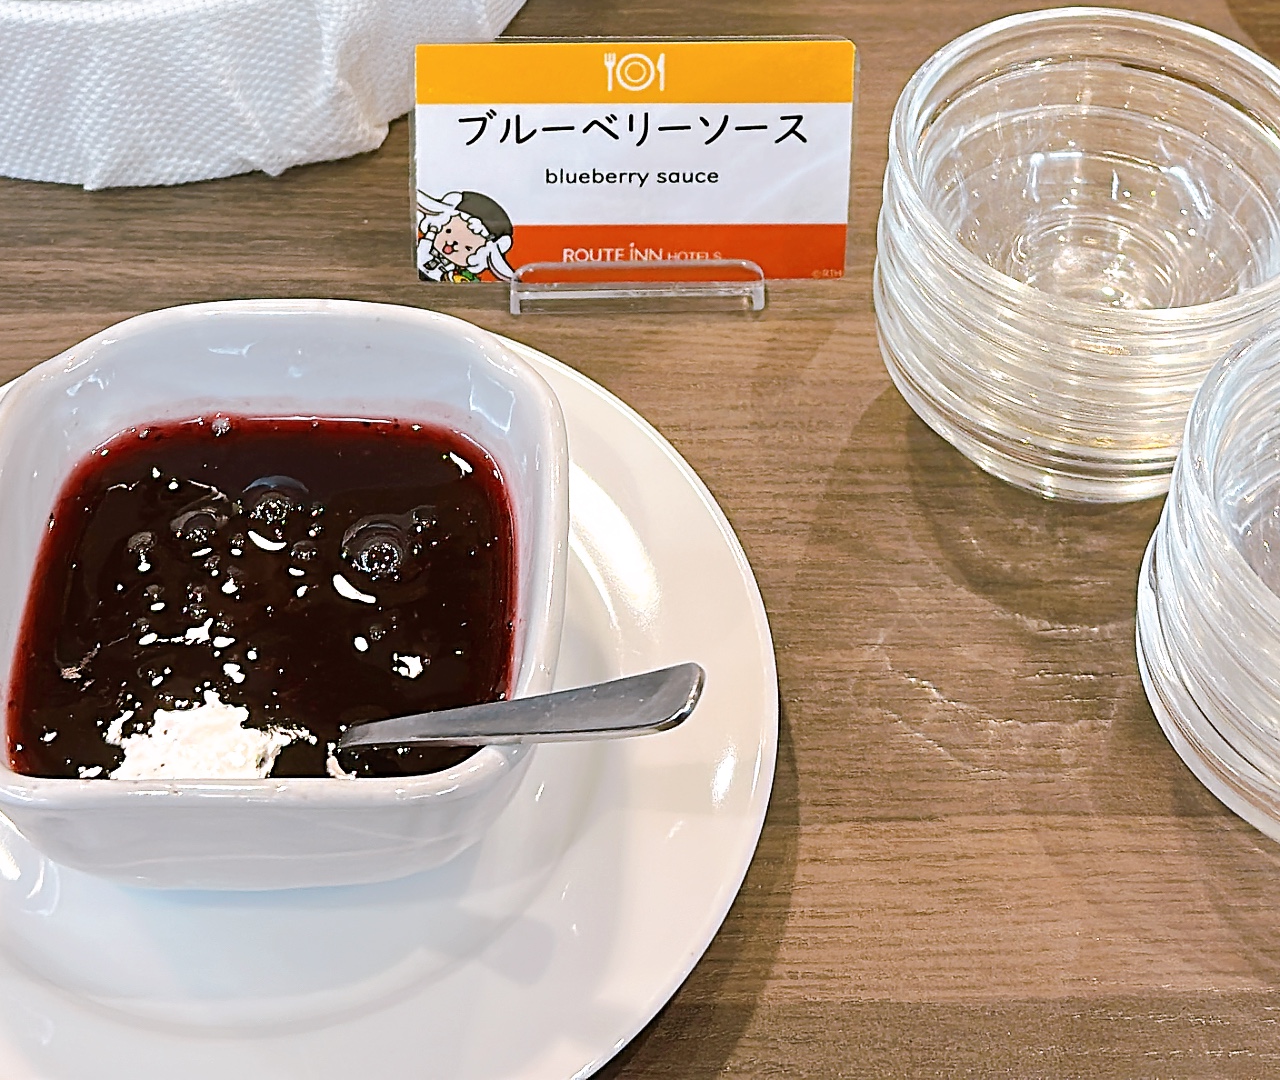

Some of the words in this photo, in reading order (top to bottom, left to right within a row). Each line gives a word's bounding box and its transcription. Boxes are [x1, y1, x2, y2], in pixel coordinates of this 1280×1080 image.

[458, 108, 808, 147] ブルーベリーソース
[545, 168, 649, 188] blueberry
[656, 171, 719, 184] sauce
[562, 248, 624, 262] ROUTE
